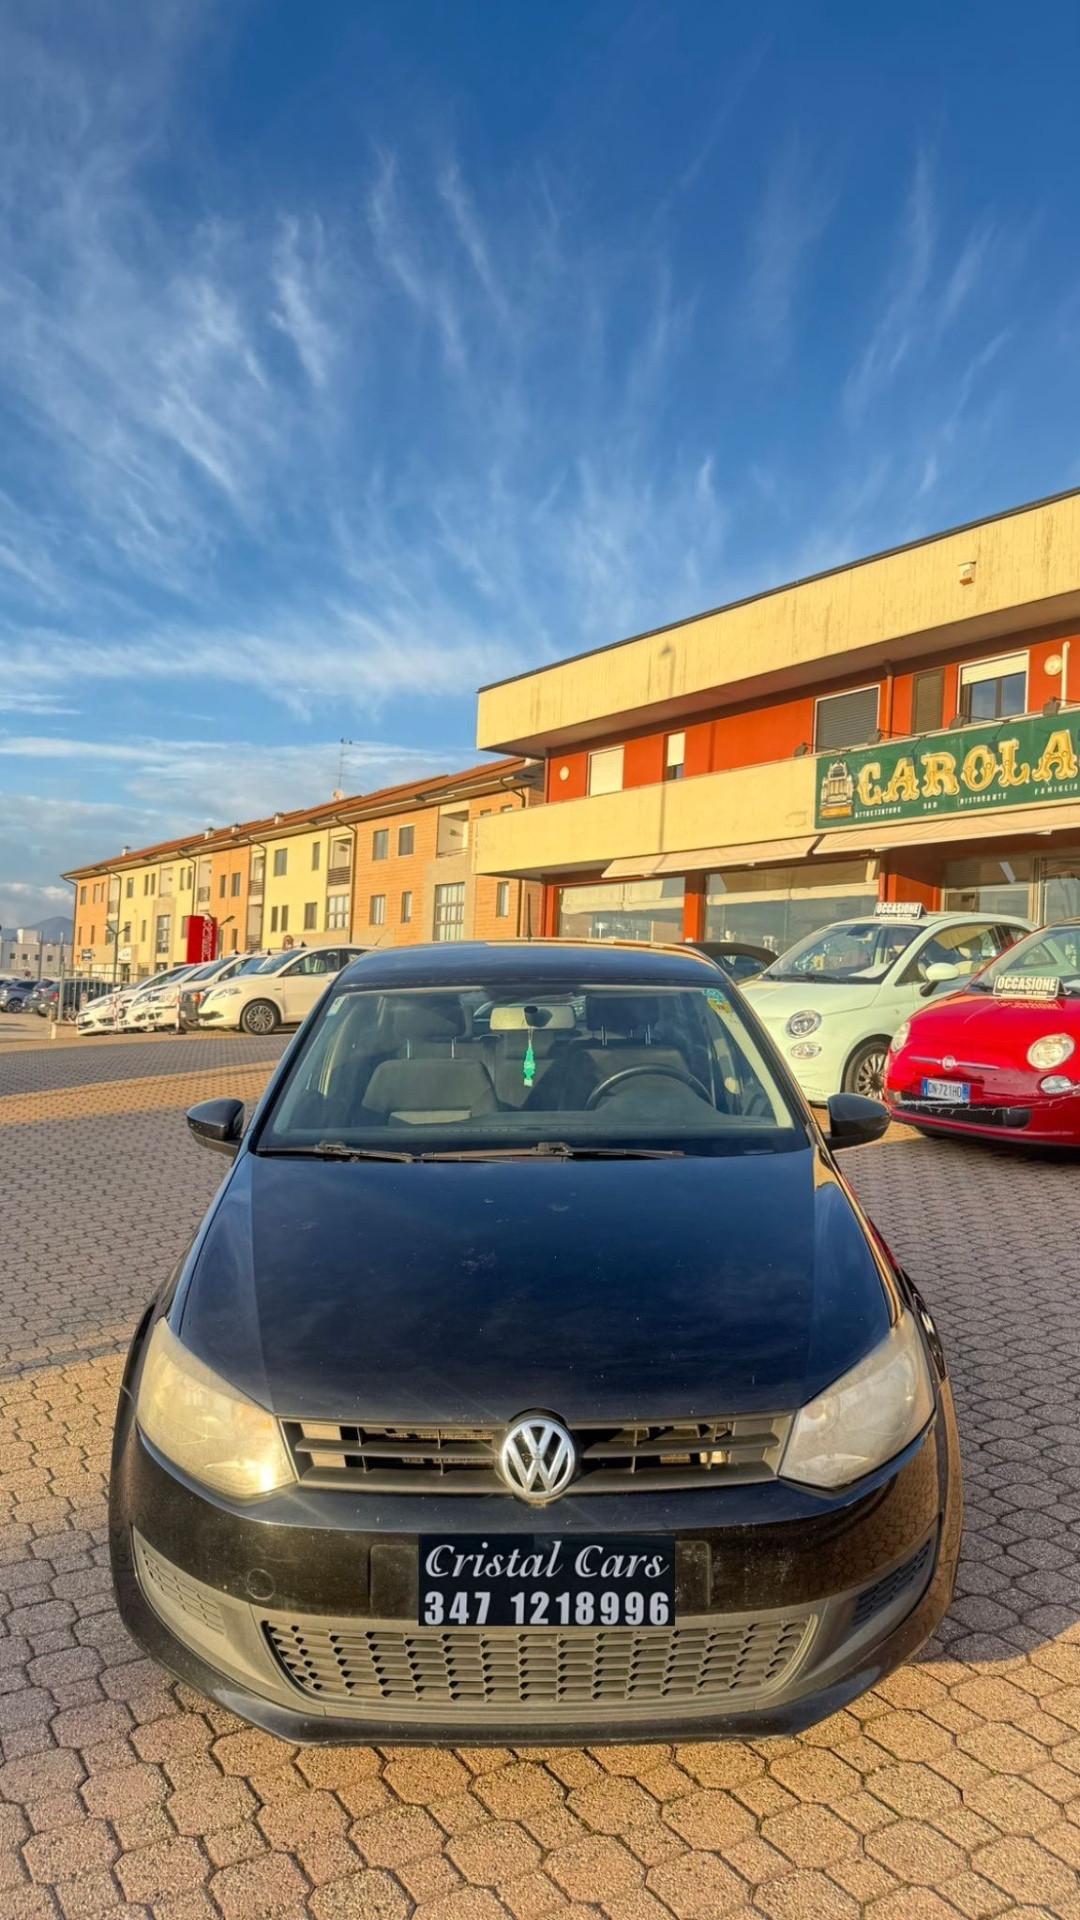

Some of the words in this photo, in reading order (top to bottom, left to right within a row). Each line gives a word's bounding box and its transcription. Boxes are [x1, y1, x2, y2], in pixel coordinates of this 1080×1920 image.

[857, 729, 1079, 806] CAROLA
[876, 902, 919, 914] OCCASIONE
[997, 976, 1057, 991] OCCASIONE
